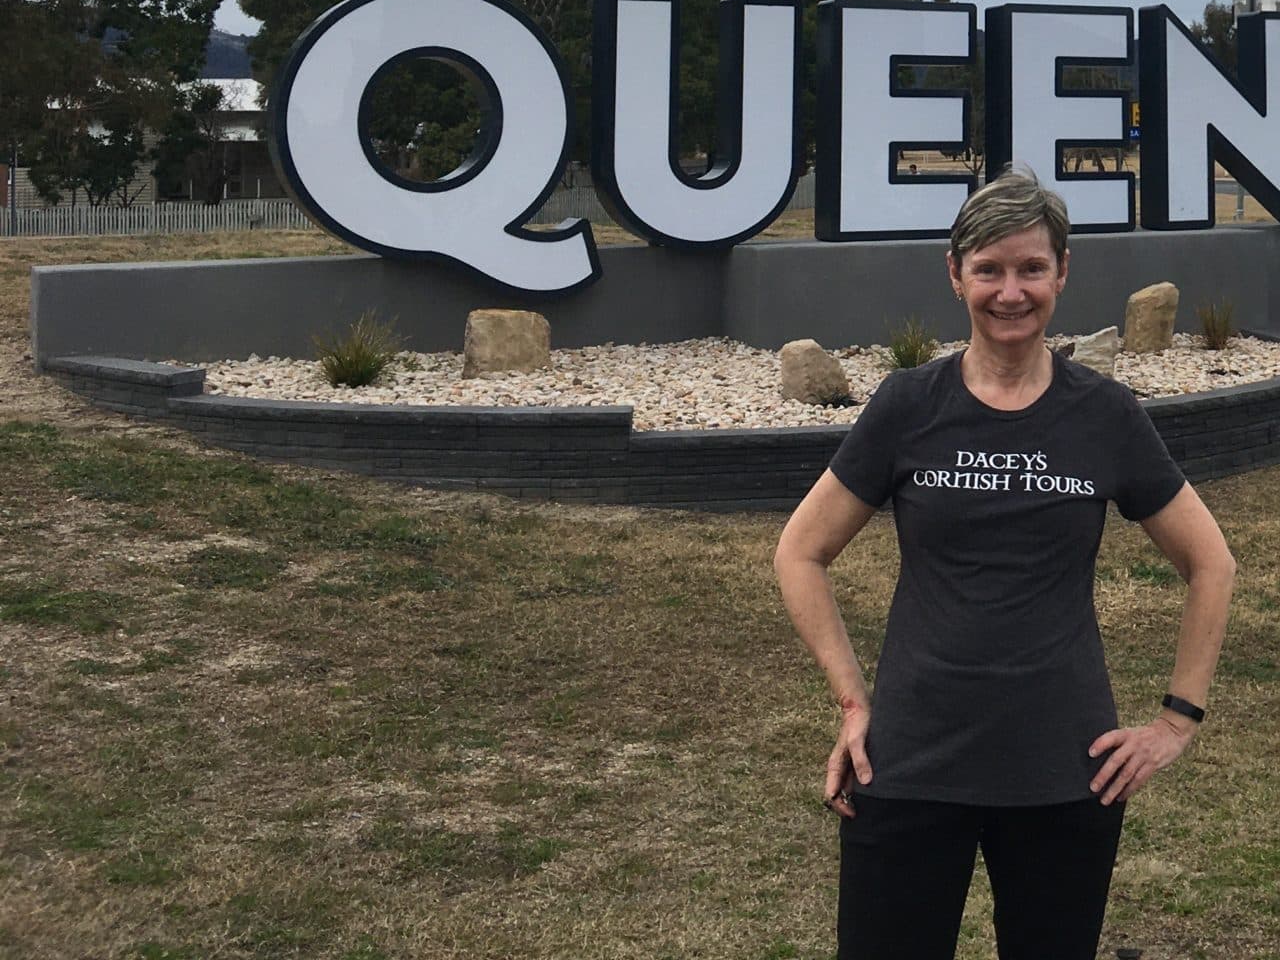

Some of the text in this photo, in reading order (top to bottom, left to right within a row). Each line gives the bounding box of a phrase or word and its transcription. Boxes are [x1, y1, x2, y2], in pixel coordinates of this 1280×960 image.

[956, 450, 1048, 471] DACEY'S
[913, 470, 1095, 495] CORNISH TOURS
